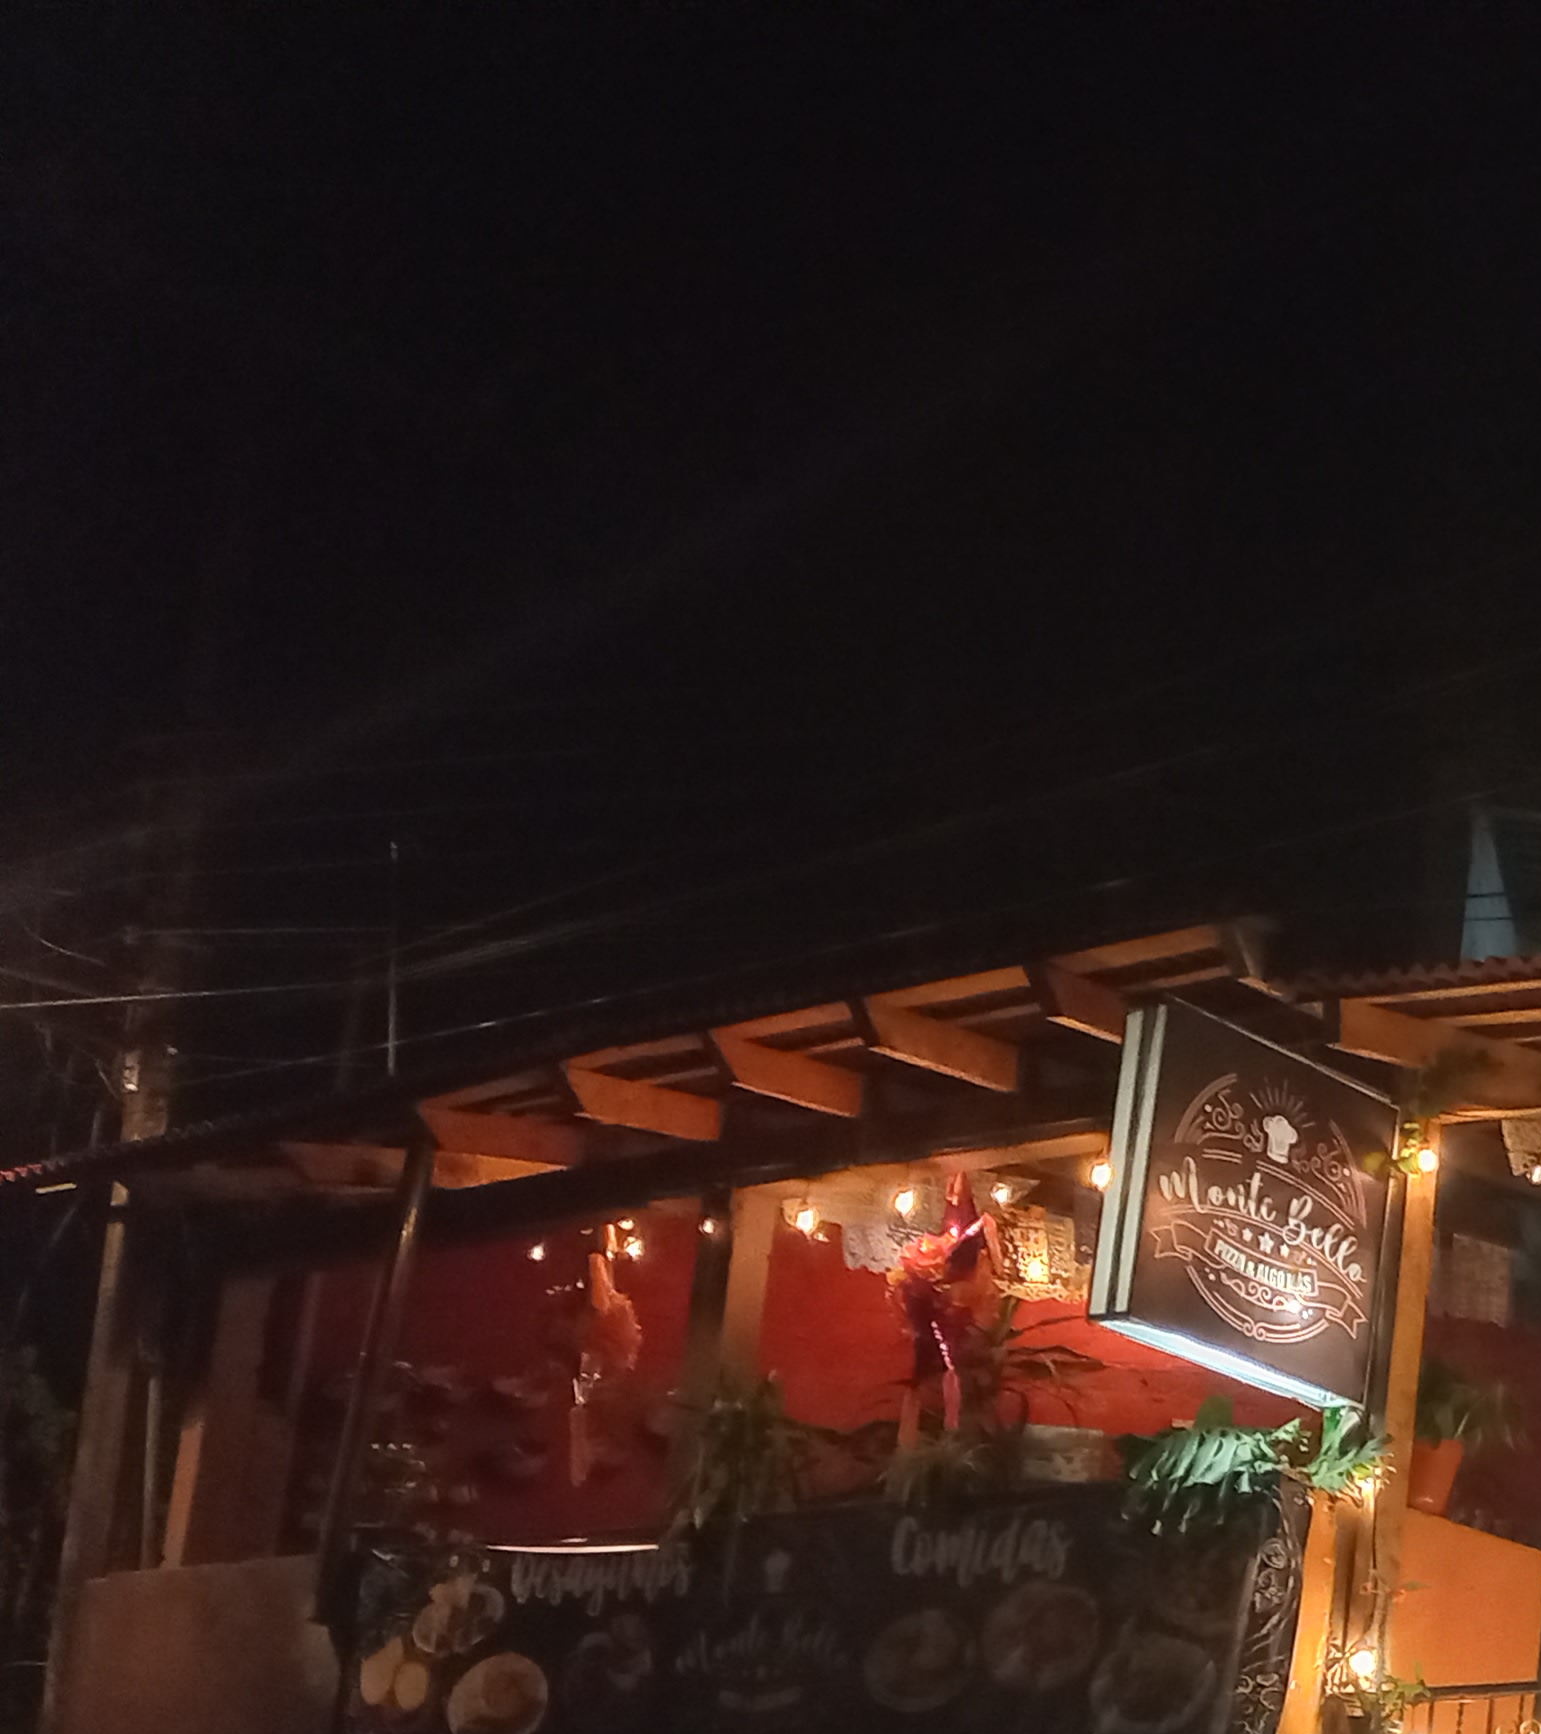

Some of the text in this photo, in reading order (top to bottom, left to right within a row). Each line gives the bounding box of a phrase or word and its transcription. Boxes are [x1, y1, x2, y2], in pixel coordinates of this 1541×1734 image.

[1160, 1156, 1367, 1283] Monte Bello
[1214, 1239, 1246, 1272] PIZZA
[1256, 1264, 1285, 1289] ALGO
